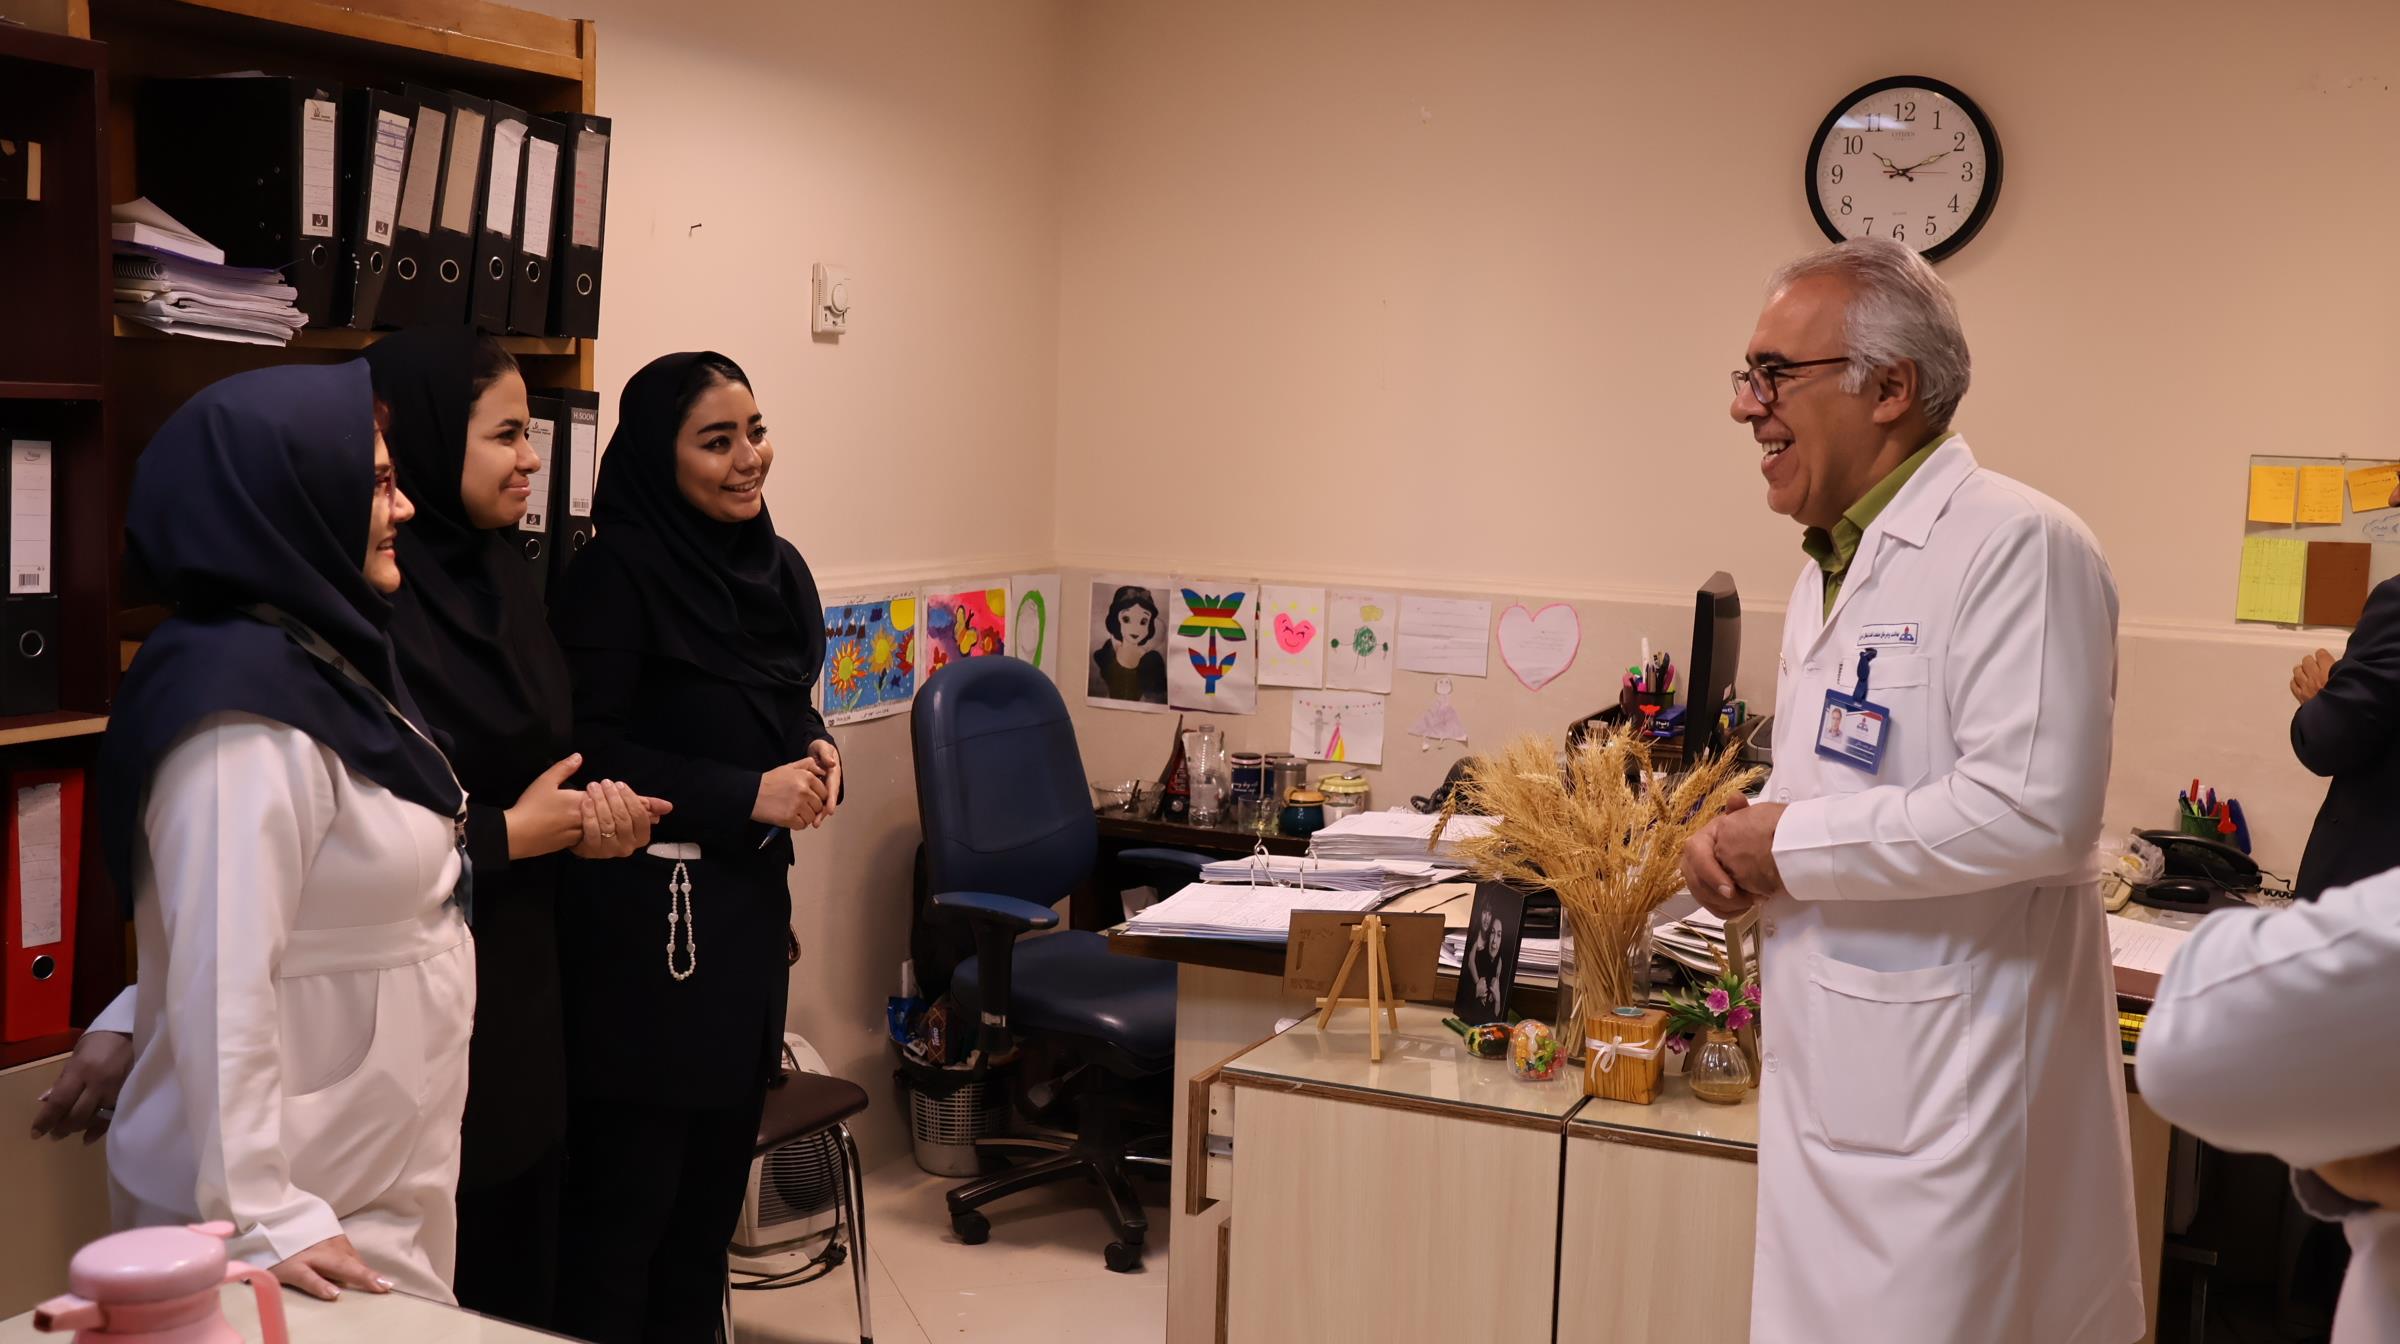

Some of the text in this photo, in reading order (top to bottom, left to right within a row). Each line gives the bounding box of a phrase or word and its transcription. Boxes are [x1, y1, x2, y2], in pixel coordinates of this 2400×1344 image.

[1894, 101, 1916, 122] 12
[1933, 110, 1942, 130] 1
[1864, 112, 1884, 133] 11
[1842, 134, 1864, 155] 10
[1953, 131, 1966, 152] 2
[1831, 164, 1844, 184] 9
[1961, 161, 1974, 182] 3
[1840, 195, 1853, 215] 8
[1947, 193, 1960, 213] 4
[1862, 217, 1875, 236] 7
[1892, 223, 1905, 242] 6
[1925, 215, 1937, 236] 5
